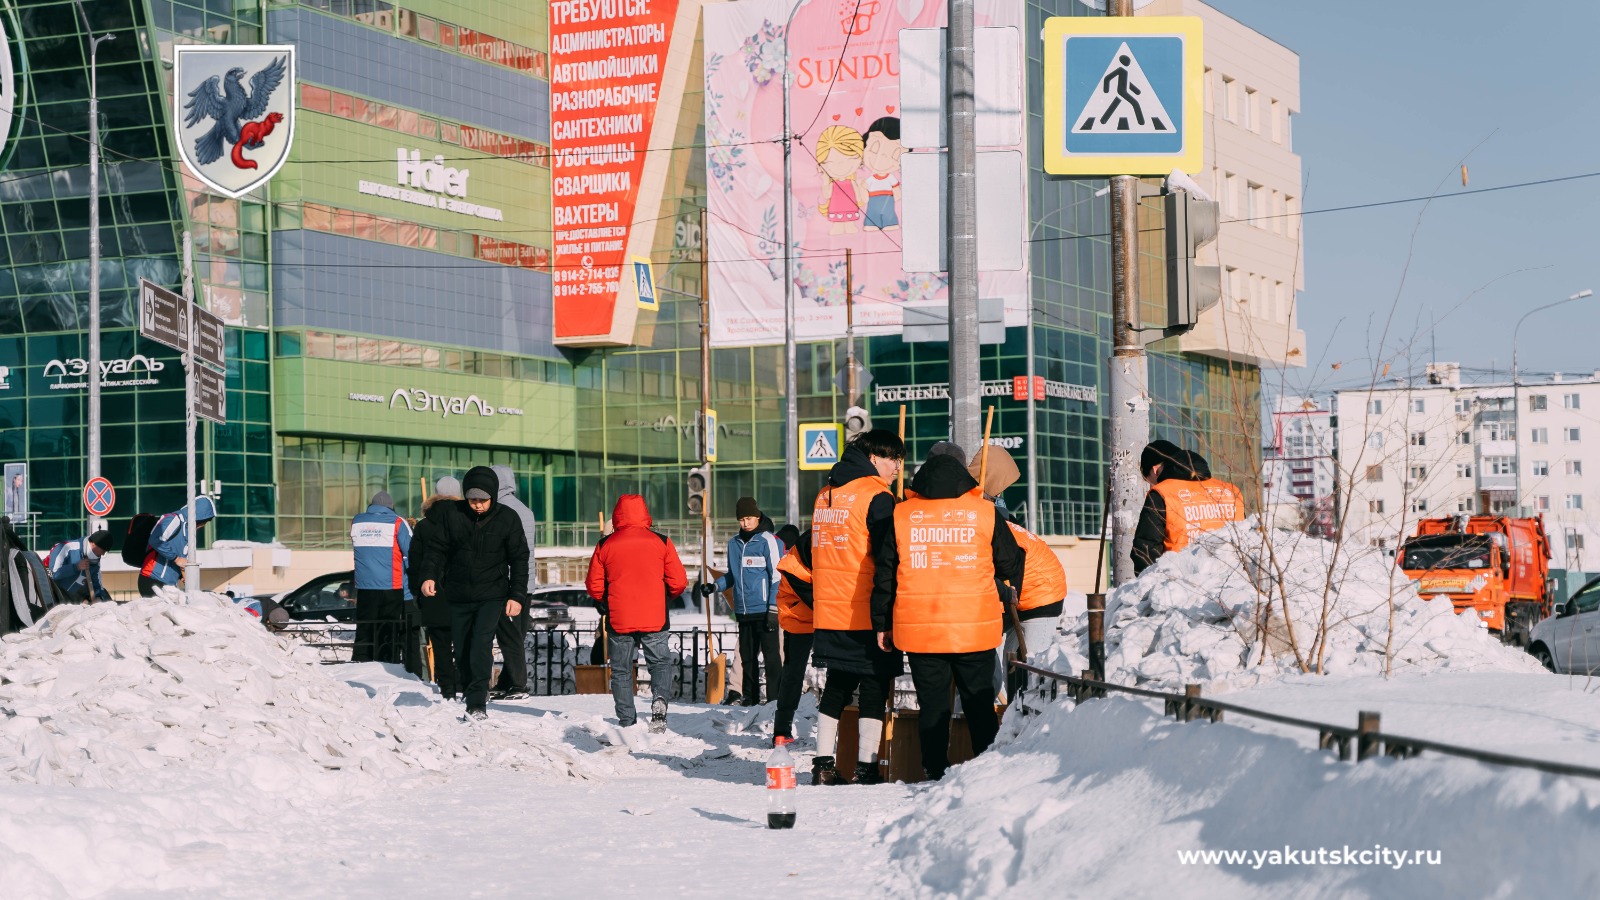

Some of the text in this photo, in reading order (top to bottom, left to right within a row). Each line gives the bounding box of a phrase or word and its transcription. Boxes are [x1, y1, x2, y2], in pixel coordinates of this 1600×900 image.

[551, 0, 651, 25] ТРЕБУЮТСЯ:
[552, 22, 665, 55] АДМИНИСТРАТОРЫ
[552, 54, 658, 84] АВТОМОЙЩИКИ
[797, 52, 899, 89] SUNDU
[552, 82, 657, 112] РАЗНОРАБОЧИЕ
[553, 113, 643, 140] САНТЕХНИКИ
[553, 142, 635, 168] УБОРЩИЦЫ
[397, 147, 470, 199] Haier
[554, 171, 631, 197] СВАРЩИКИ
[554, 202, 619, 226] ВАХТЕРЫ
[555, 226, 627, 242] ПРЕДОСТАВЛЯЕТСЯ
[555, 239, 624, 255] ЖИЛЬЕ И ПИТАНИЕ
[554, 270, 561, 282] 8
[554, 285, 561, 297] 8
[878, 384, 949, 403] KÜCHENLA
[813, 508, 849, 525] ВОЛОНТЕР
[1184, 503, 1236, 522] ВОЛОНТЕР
[910, 527, 976, 543] ВОЛОНТЕР
[910, 552, 928, 569] 100
